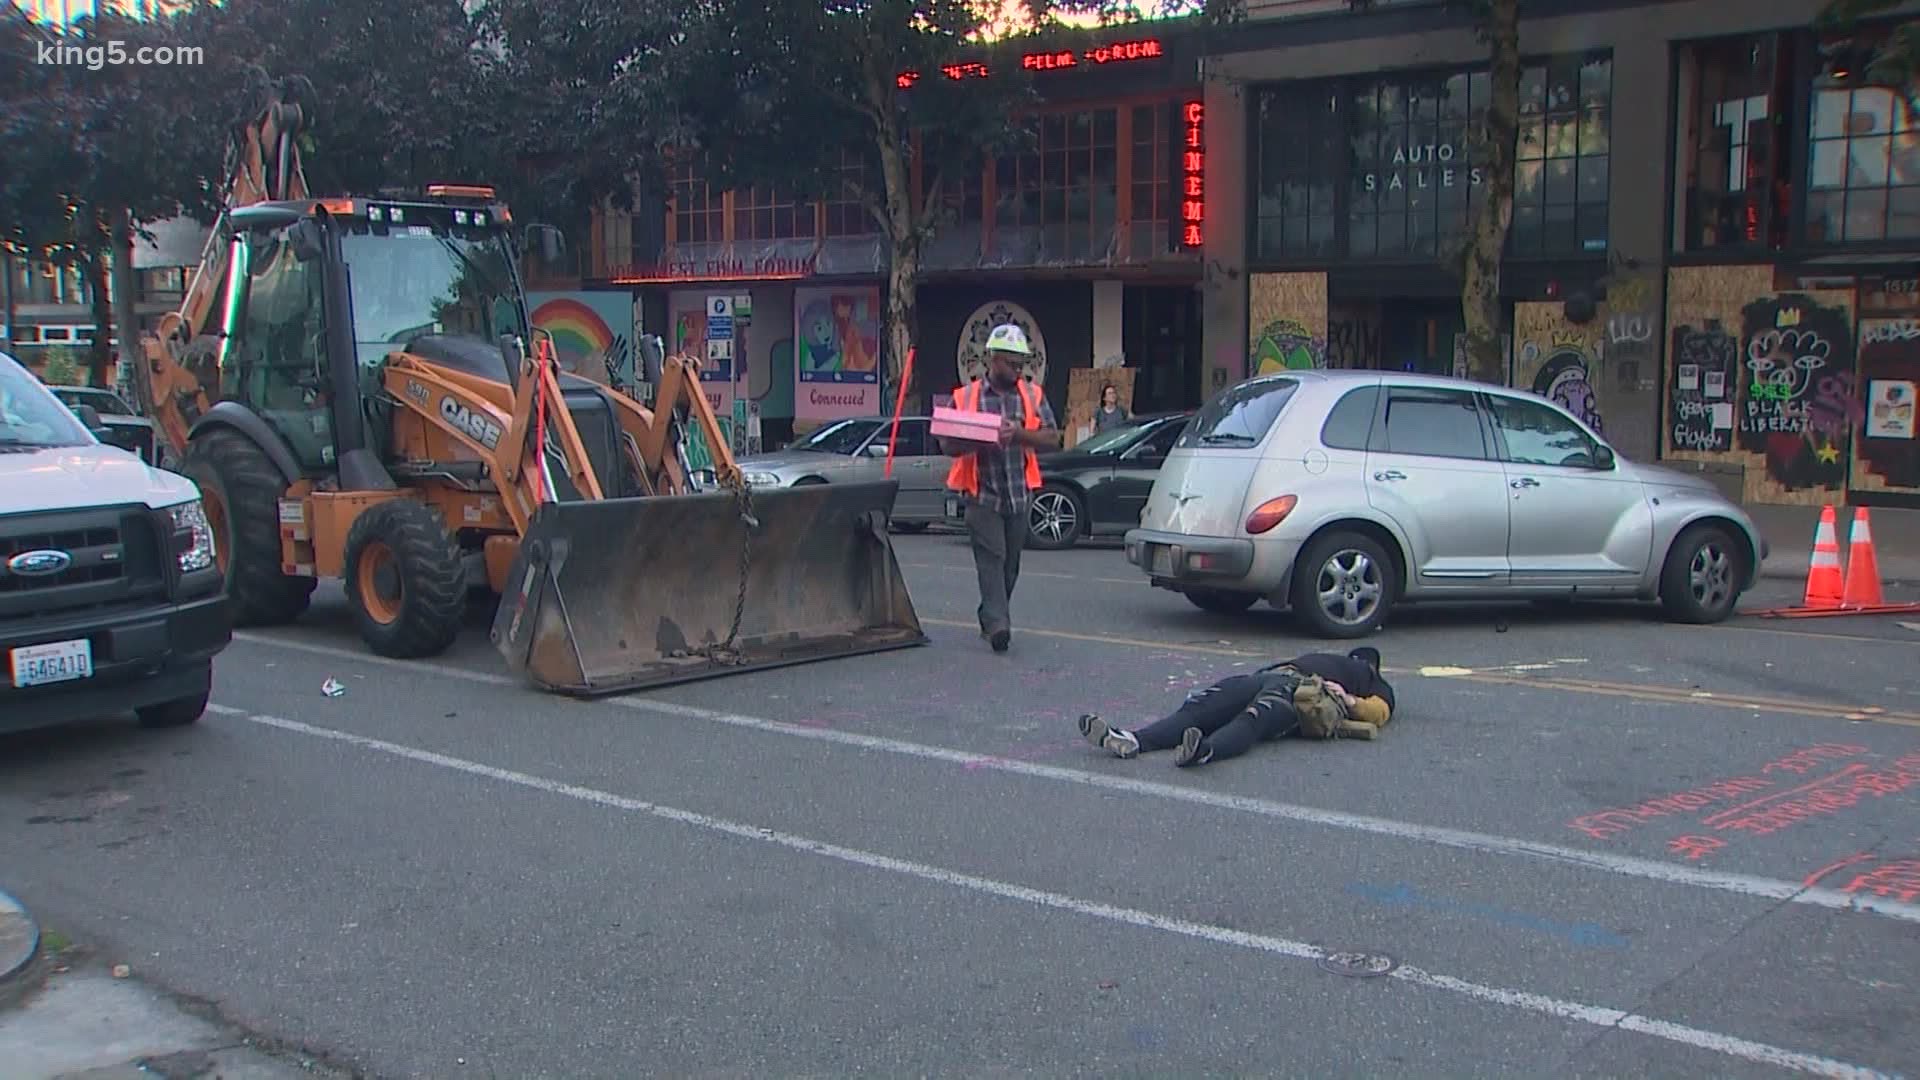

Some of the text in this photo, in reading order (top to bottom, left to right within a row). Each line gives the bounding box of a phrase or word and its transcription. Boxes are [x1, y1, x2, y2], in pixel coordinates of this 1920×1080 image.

[1393, 144, 1454, 164] AUTO
[1185, 103, 1204, 246] CINEMA
[1365, 168, 1483, 191] SALES
[810, 388, 865, 406] Connected
[1748, 400, 1814, 417] BLACK
[440, 395, 502, 452] CASE
[1741, 416, 1815, 433] LIBERATI
